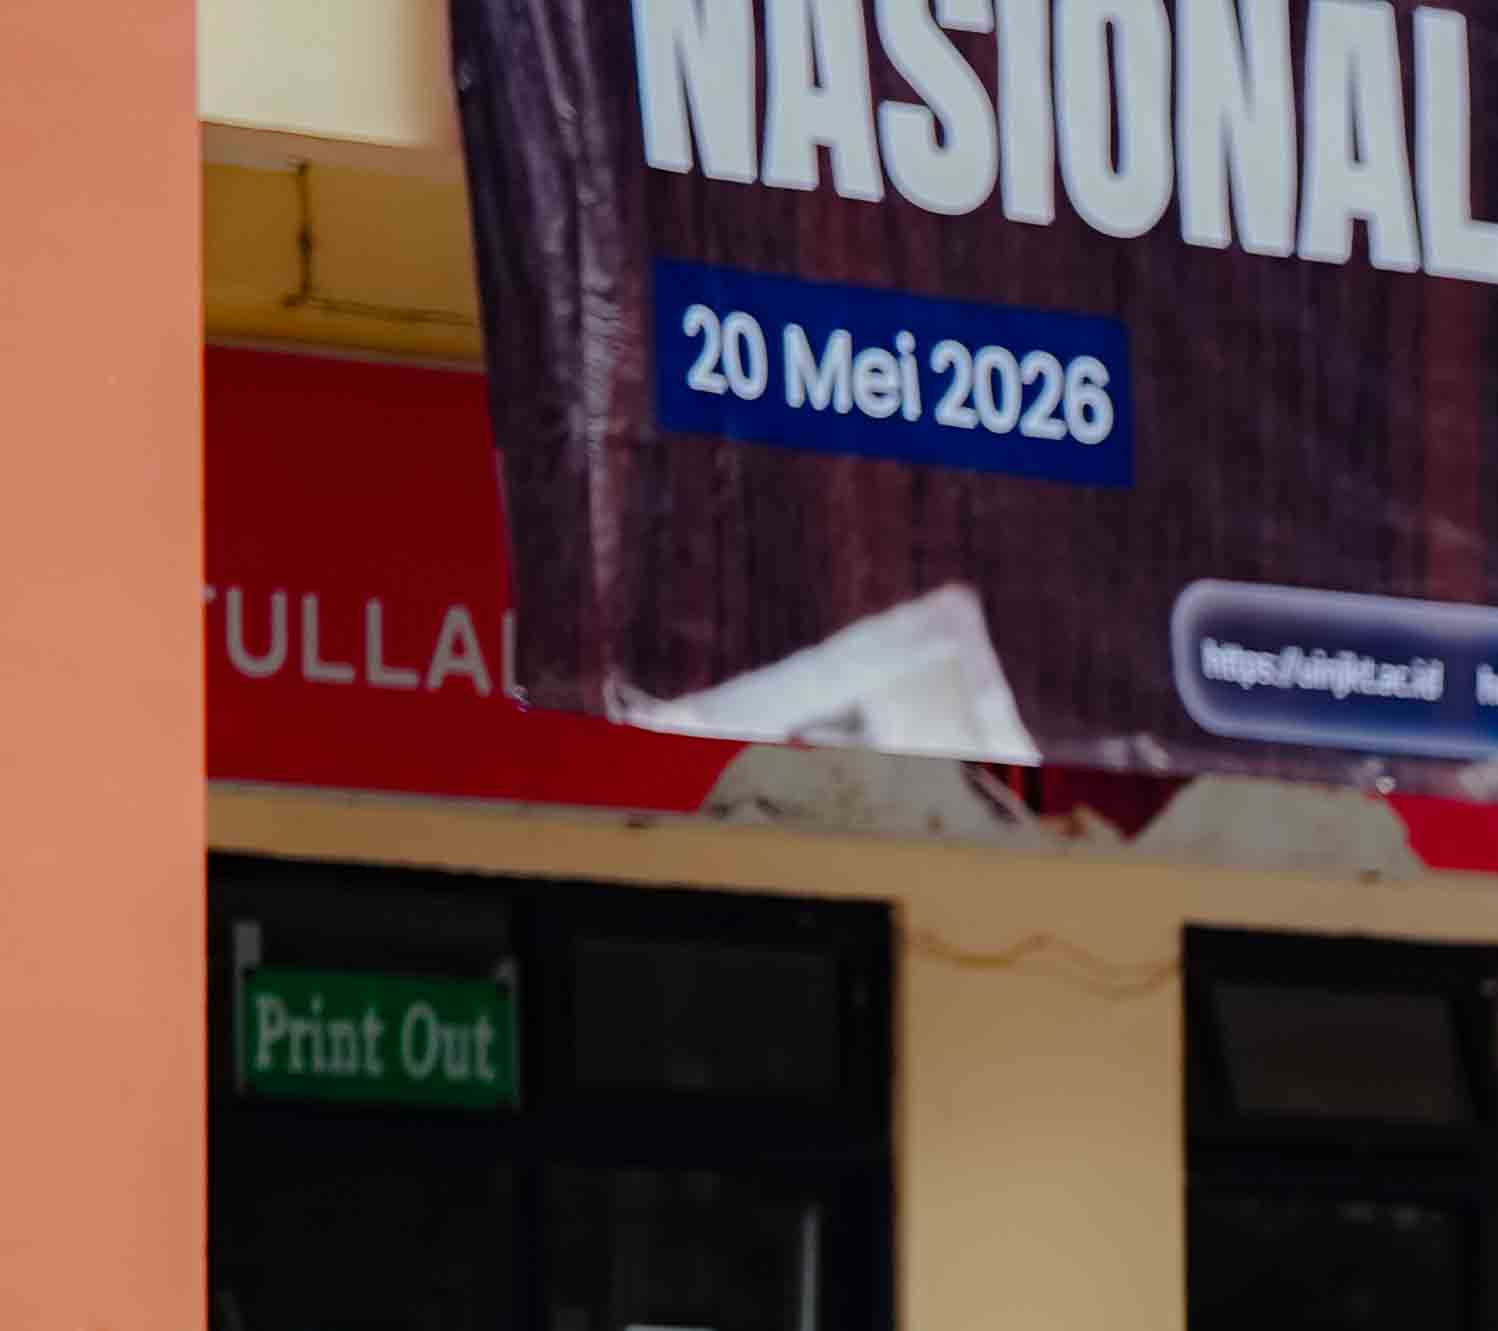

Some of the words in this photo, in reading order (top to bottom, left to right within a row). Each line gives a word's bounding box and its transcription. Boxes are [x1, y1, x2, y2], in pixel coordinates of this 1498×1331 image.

[681, 302, 768, 400] 20
[783, 322, 922, 422] Mei
[930, 338, 1115, 447] 2026
[203, 584, 517, 700] ULLA
[255, 992, 384, 1079] Print
[402, 1001, 496, 1082] Out
